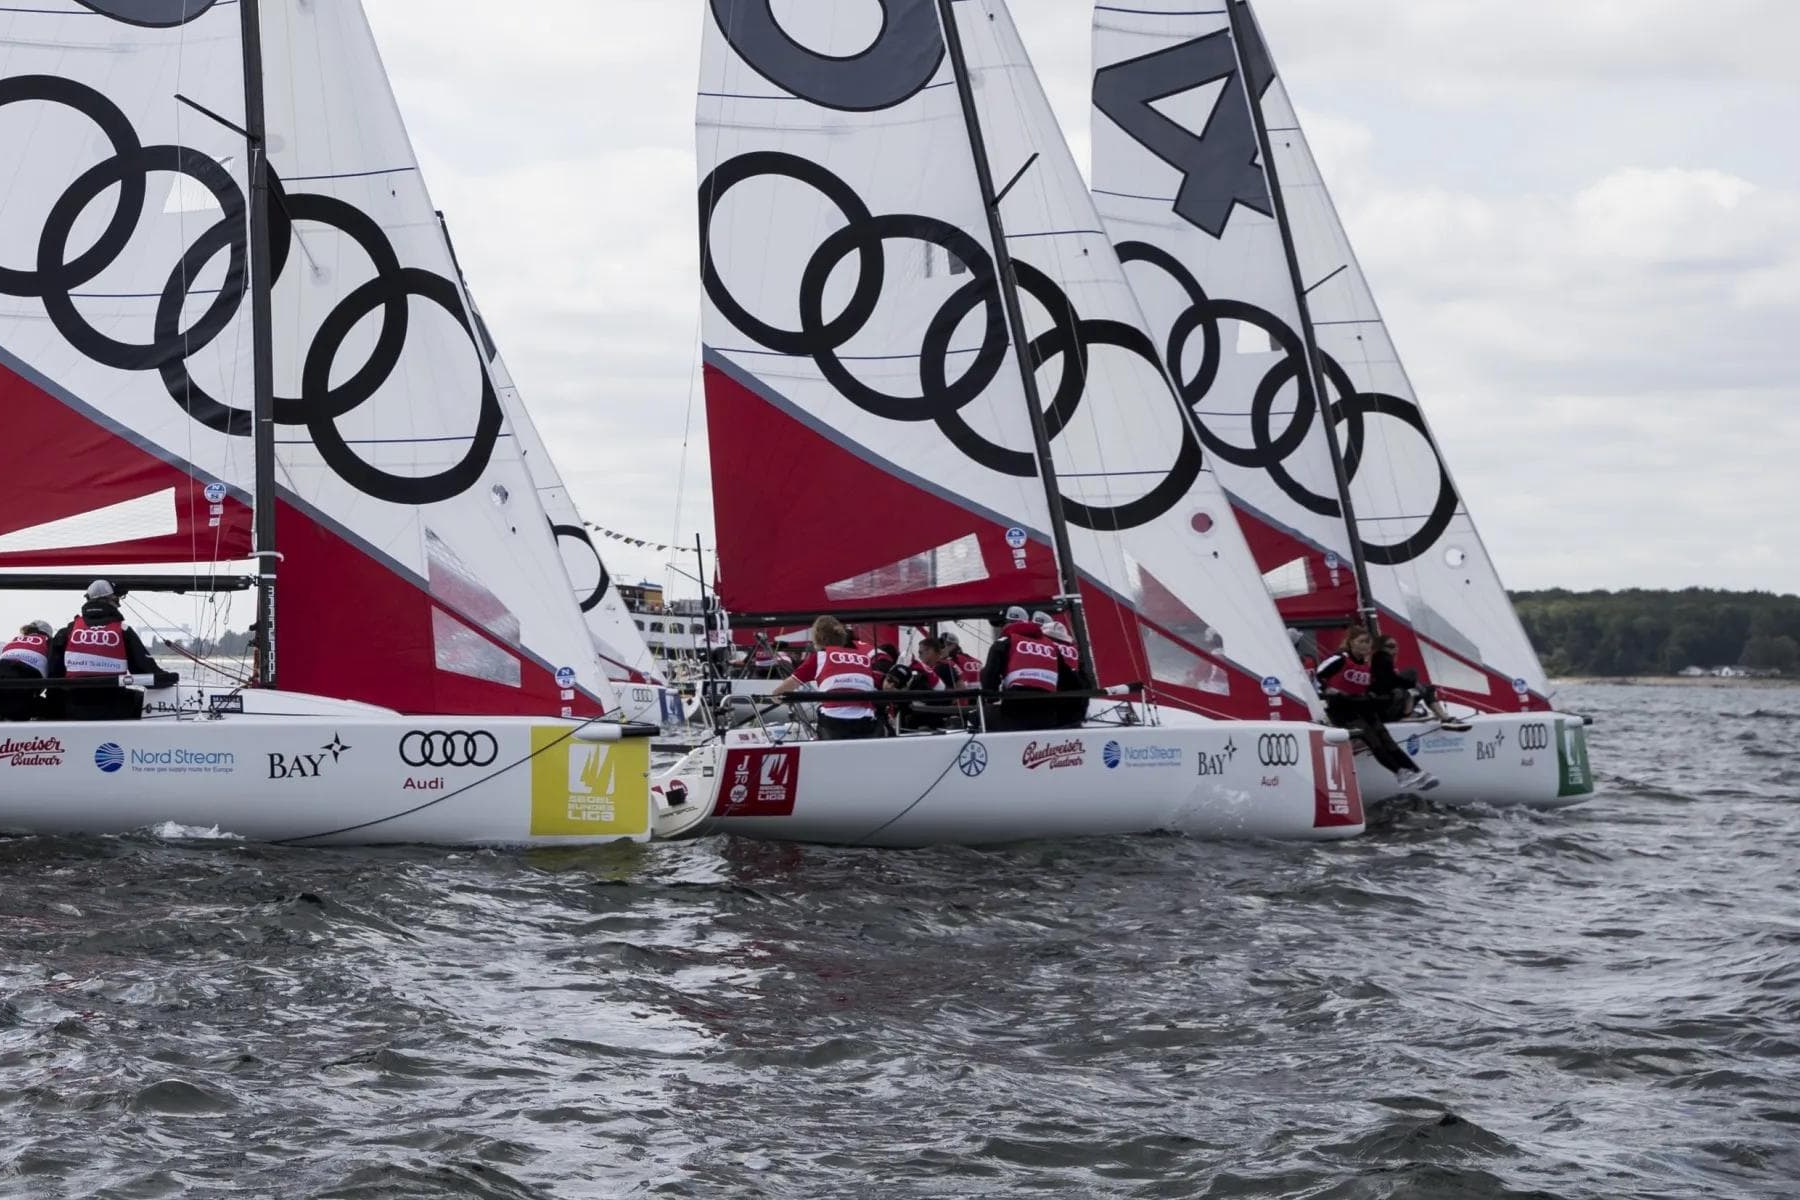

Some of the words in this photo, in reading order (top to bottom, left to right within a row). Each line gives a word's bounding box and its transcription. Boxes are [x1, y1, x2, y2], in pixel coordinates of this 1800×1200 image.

[1092, 0, 1275, 239] 4
[131, 748, 171, 765] Nord
[174, 748, 234, 765] Stream
[1022, 739, 1084, 766] Budweiser
[1476, 740, 1498, 760] BAY
[11, 752, 62, 767] Budvar
[267, 752, 326, 779] BAY
[737, 755, 750, 770] J
[1198, 751, 1226, 775] BAY
[403, 777, 444, 790] Audi
[734, 774, 748, 784] 70
[1261, 776, 1279, 787] Audi
